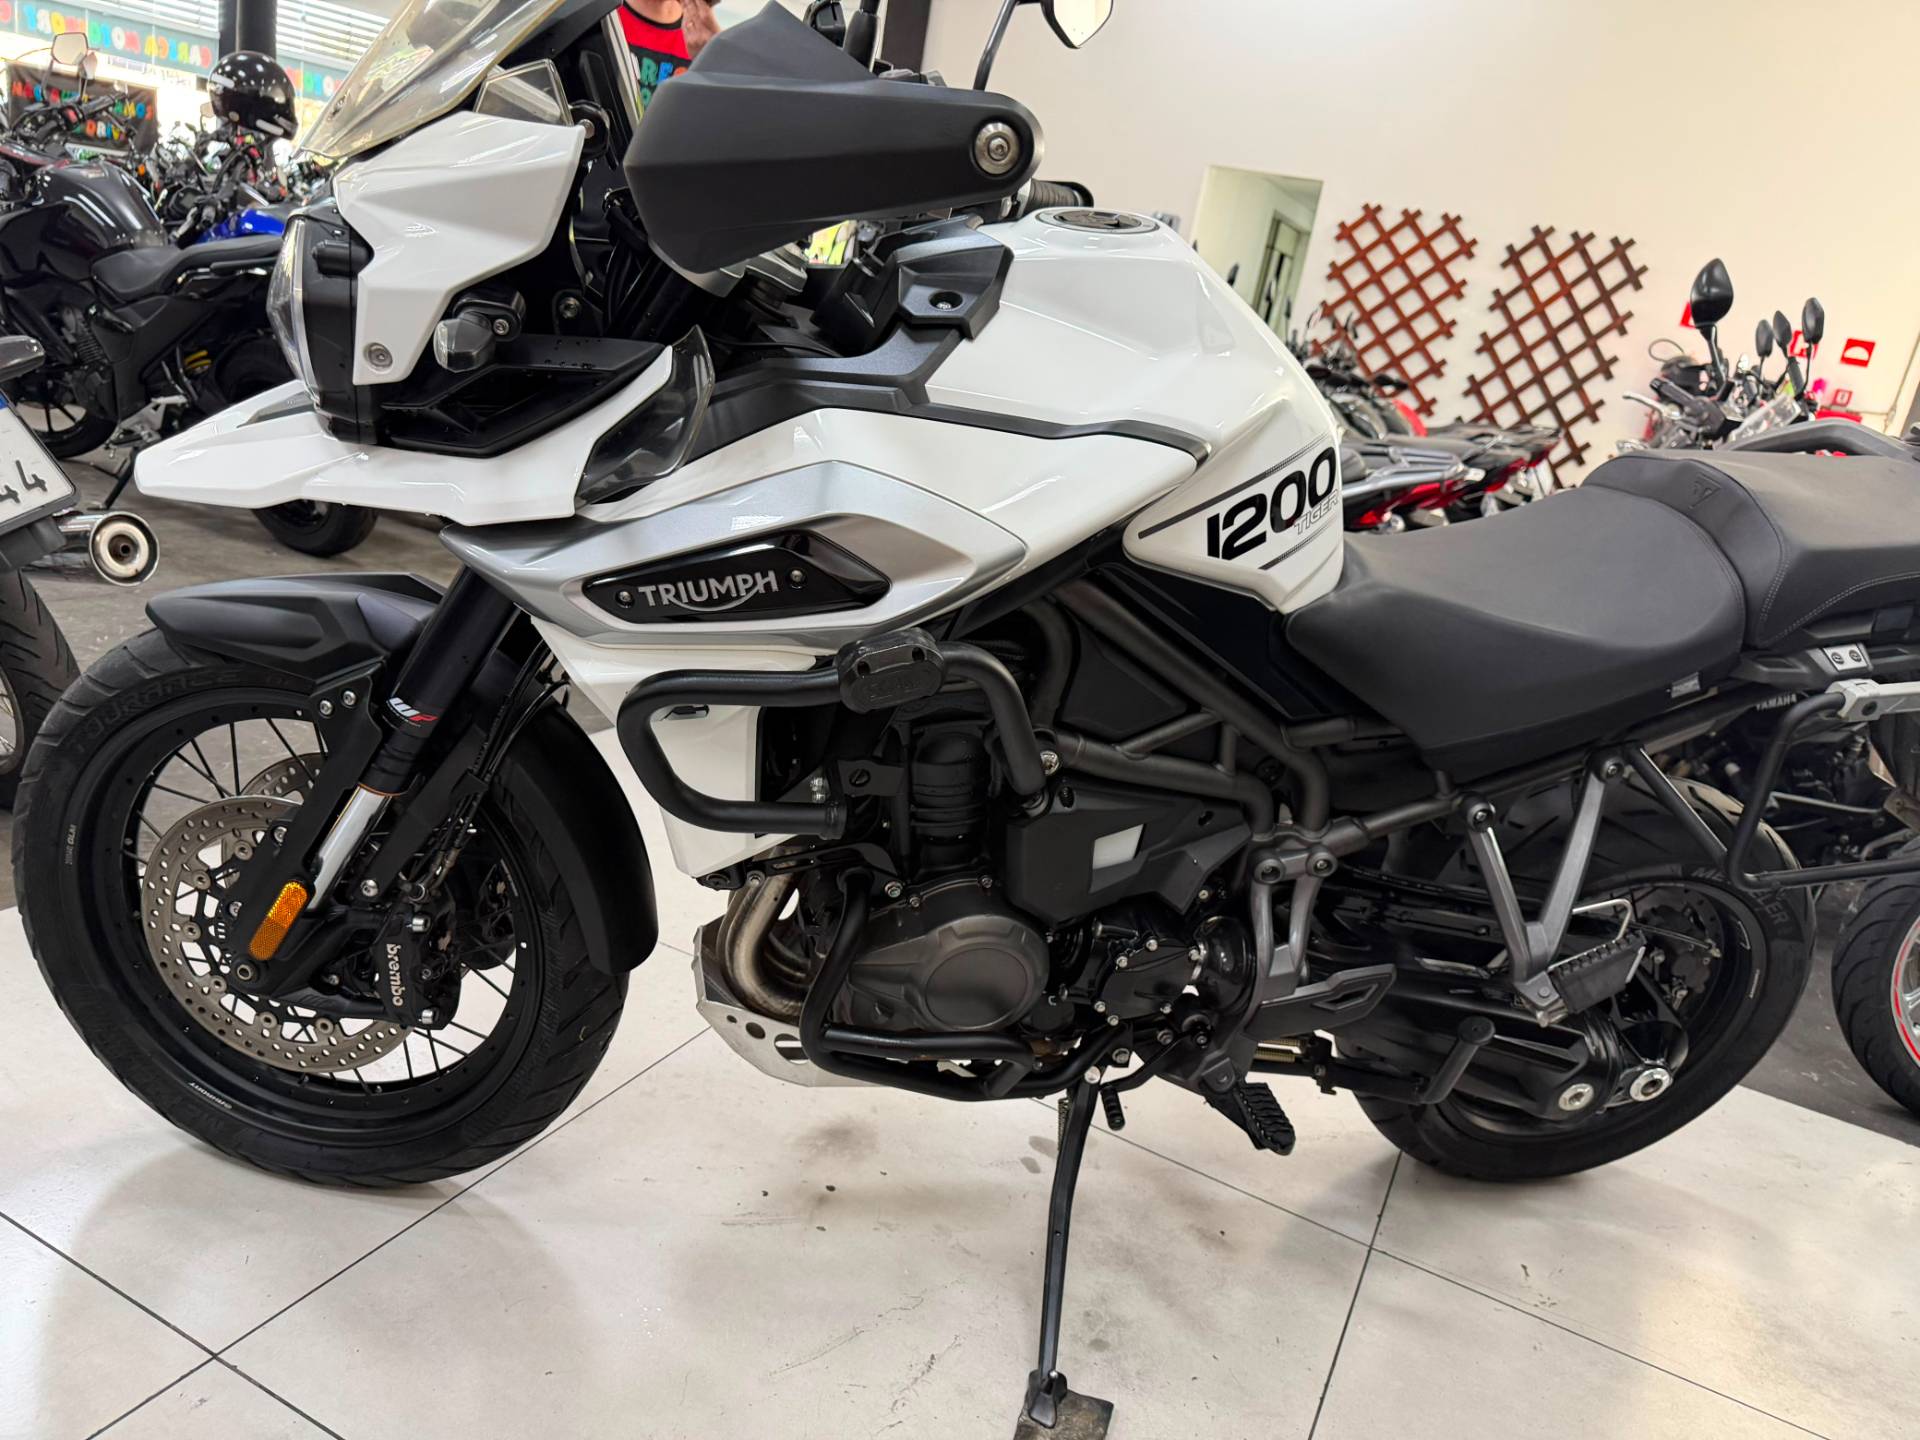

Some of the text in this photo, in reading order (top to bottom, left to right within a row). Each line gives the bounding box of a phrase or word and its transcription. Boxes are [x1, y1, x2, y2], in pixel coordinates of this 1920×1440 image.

[1207, 446, 1337, 561] 1200
[1293, 488, 1340, 535] TIGER
[637, 569, 780, 611] TRIUMPH
[1755, 693, 1798, 711] YAMAHA
[386, 943, 404, 1007] brembo
